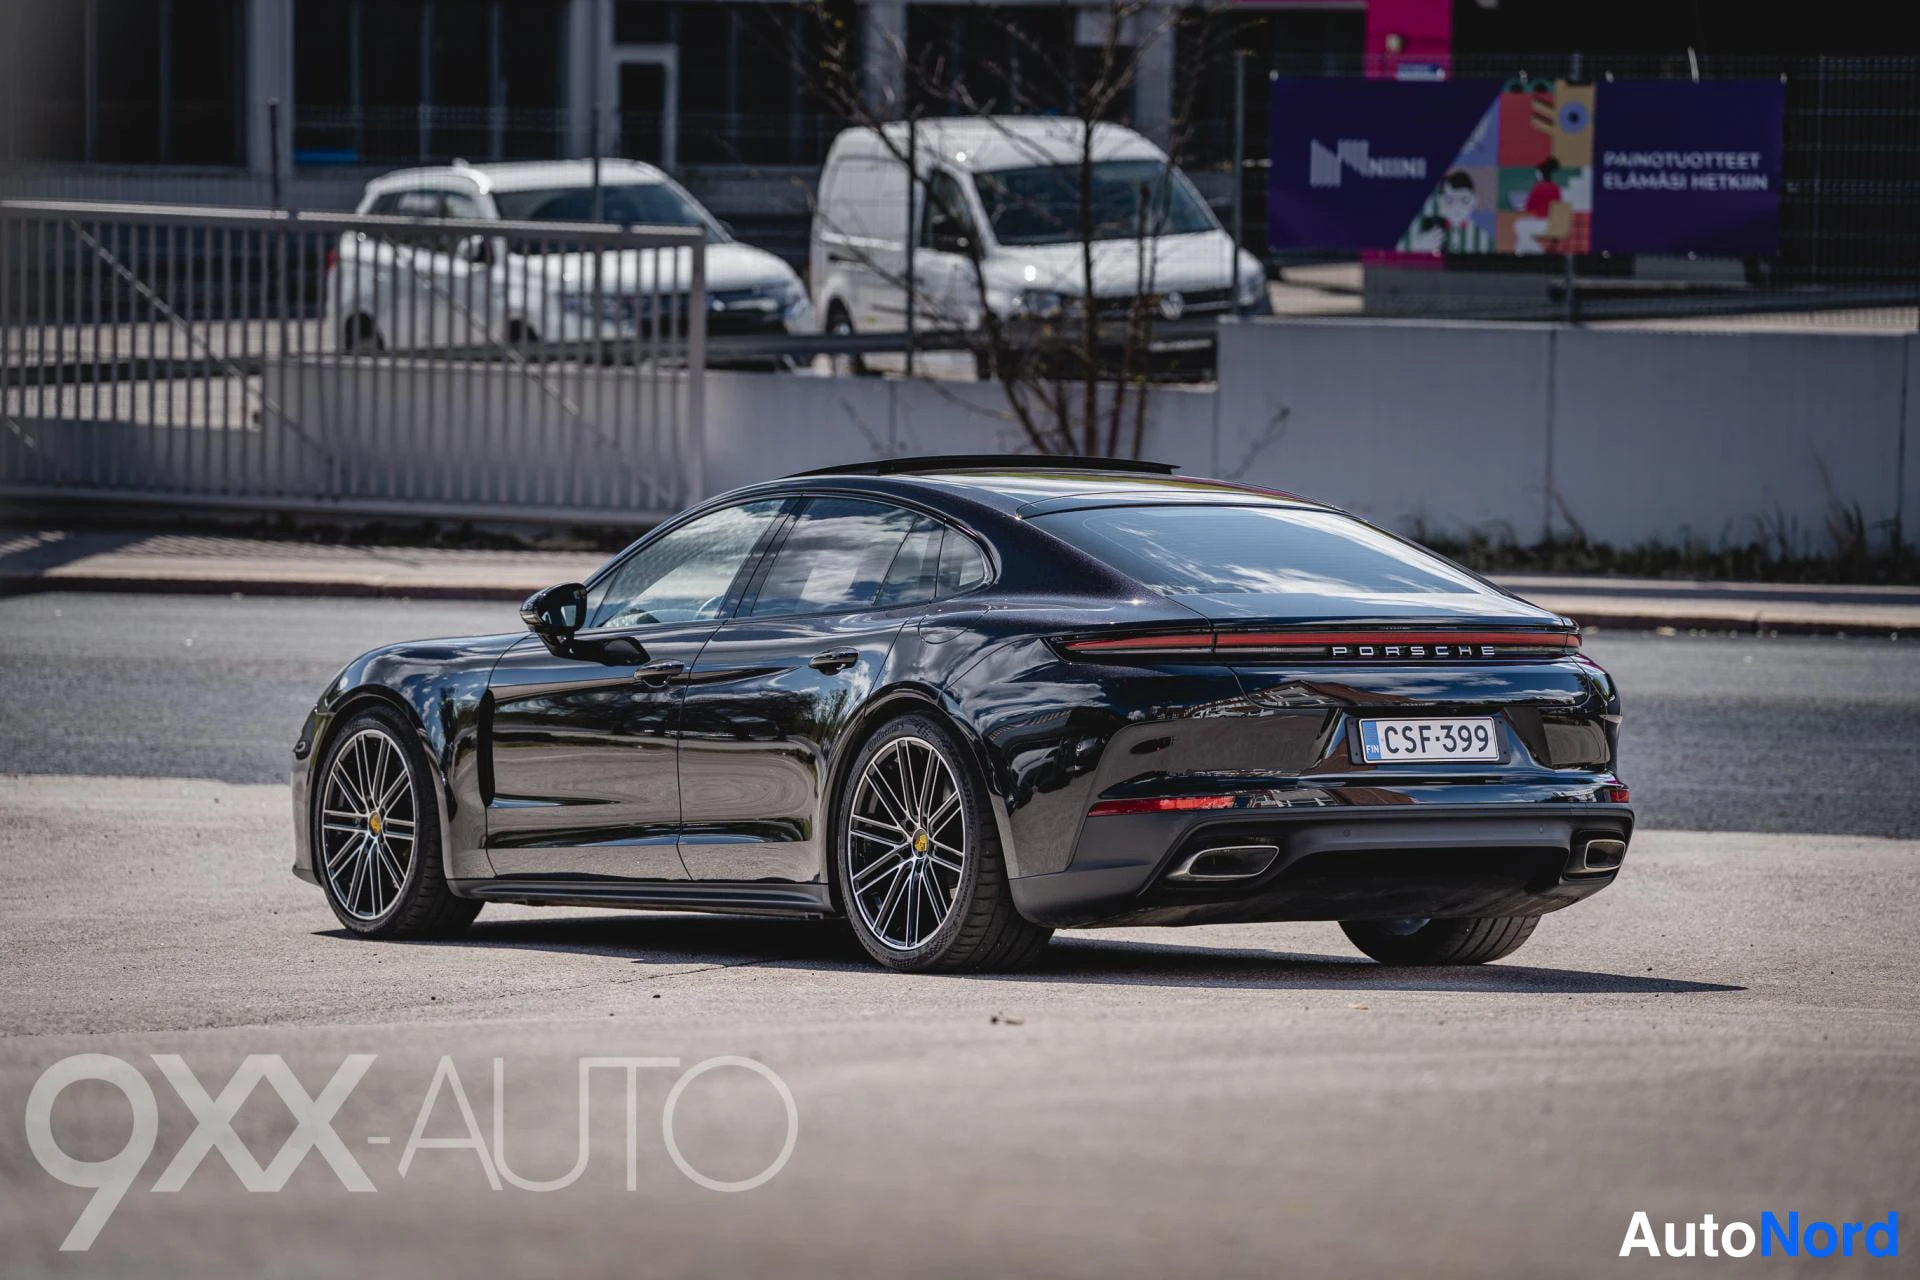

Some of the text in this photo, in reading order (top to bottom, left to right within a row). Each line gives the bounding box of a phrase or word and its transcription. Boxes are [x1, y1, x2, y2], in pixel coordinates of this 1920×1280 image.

[1603, 152, 1761, 169] PAINOTUOTTEET
[1691, 173, 1768, 190] HETKIIN
[1332, 646, 1495, 656] PORSCHE
[1384, 725, 1489, 754] CSF-399
[1366, 744, 1380, 754] FIN
